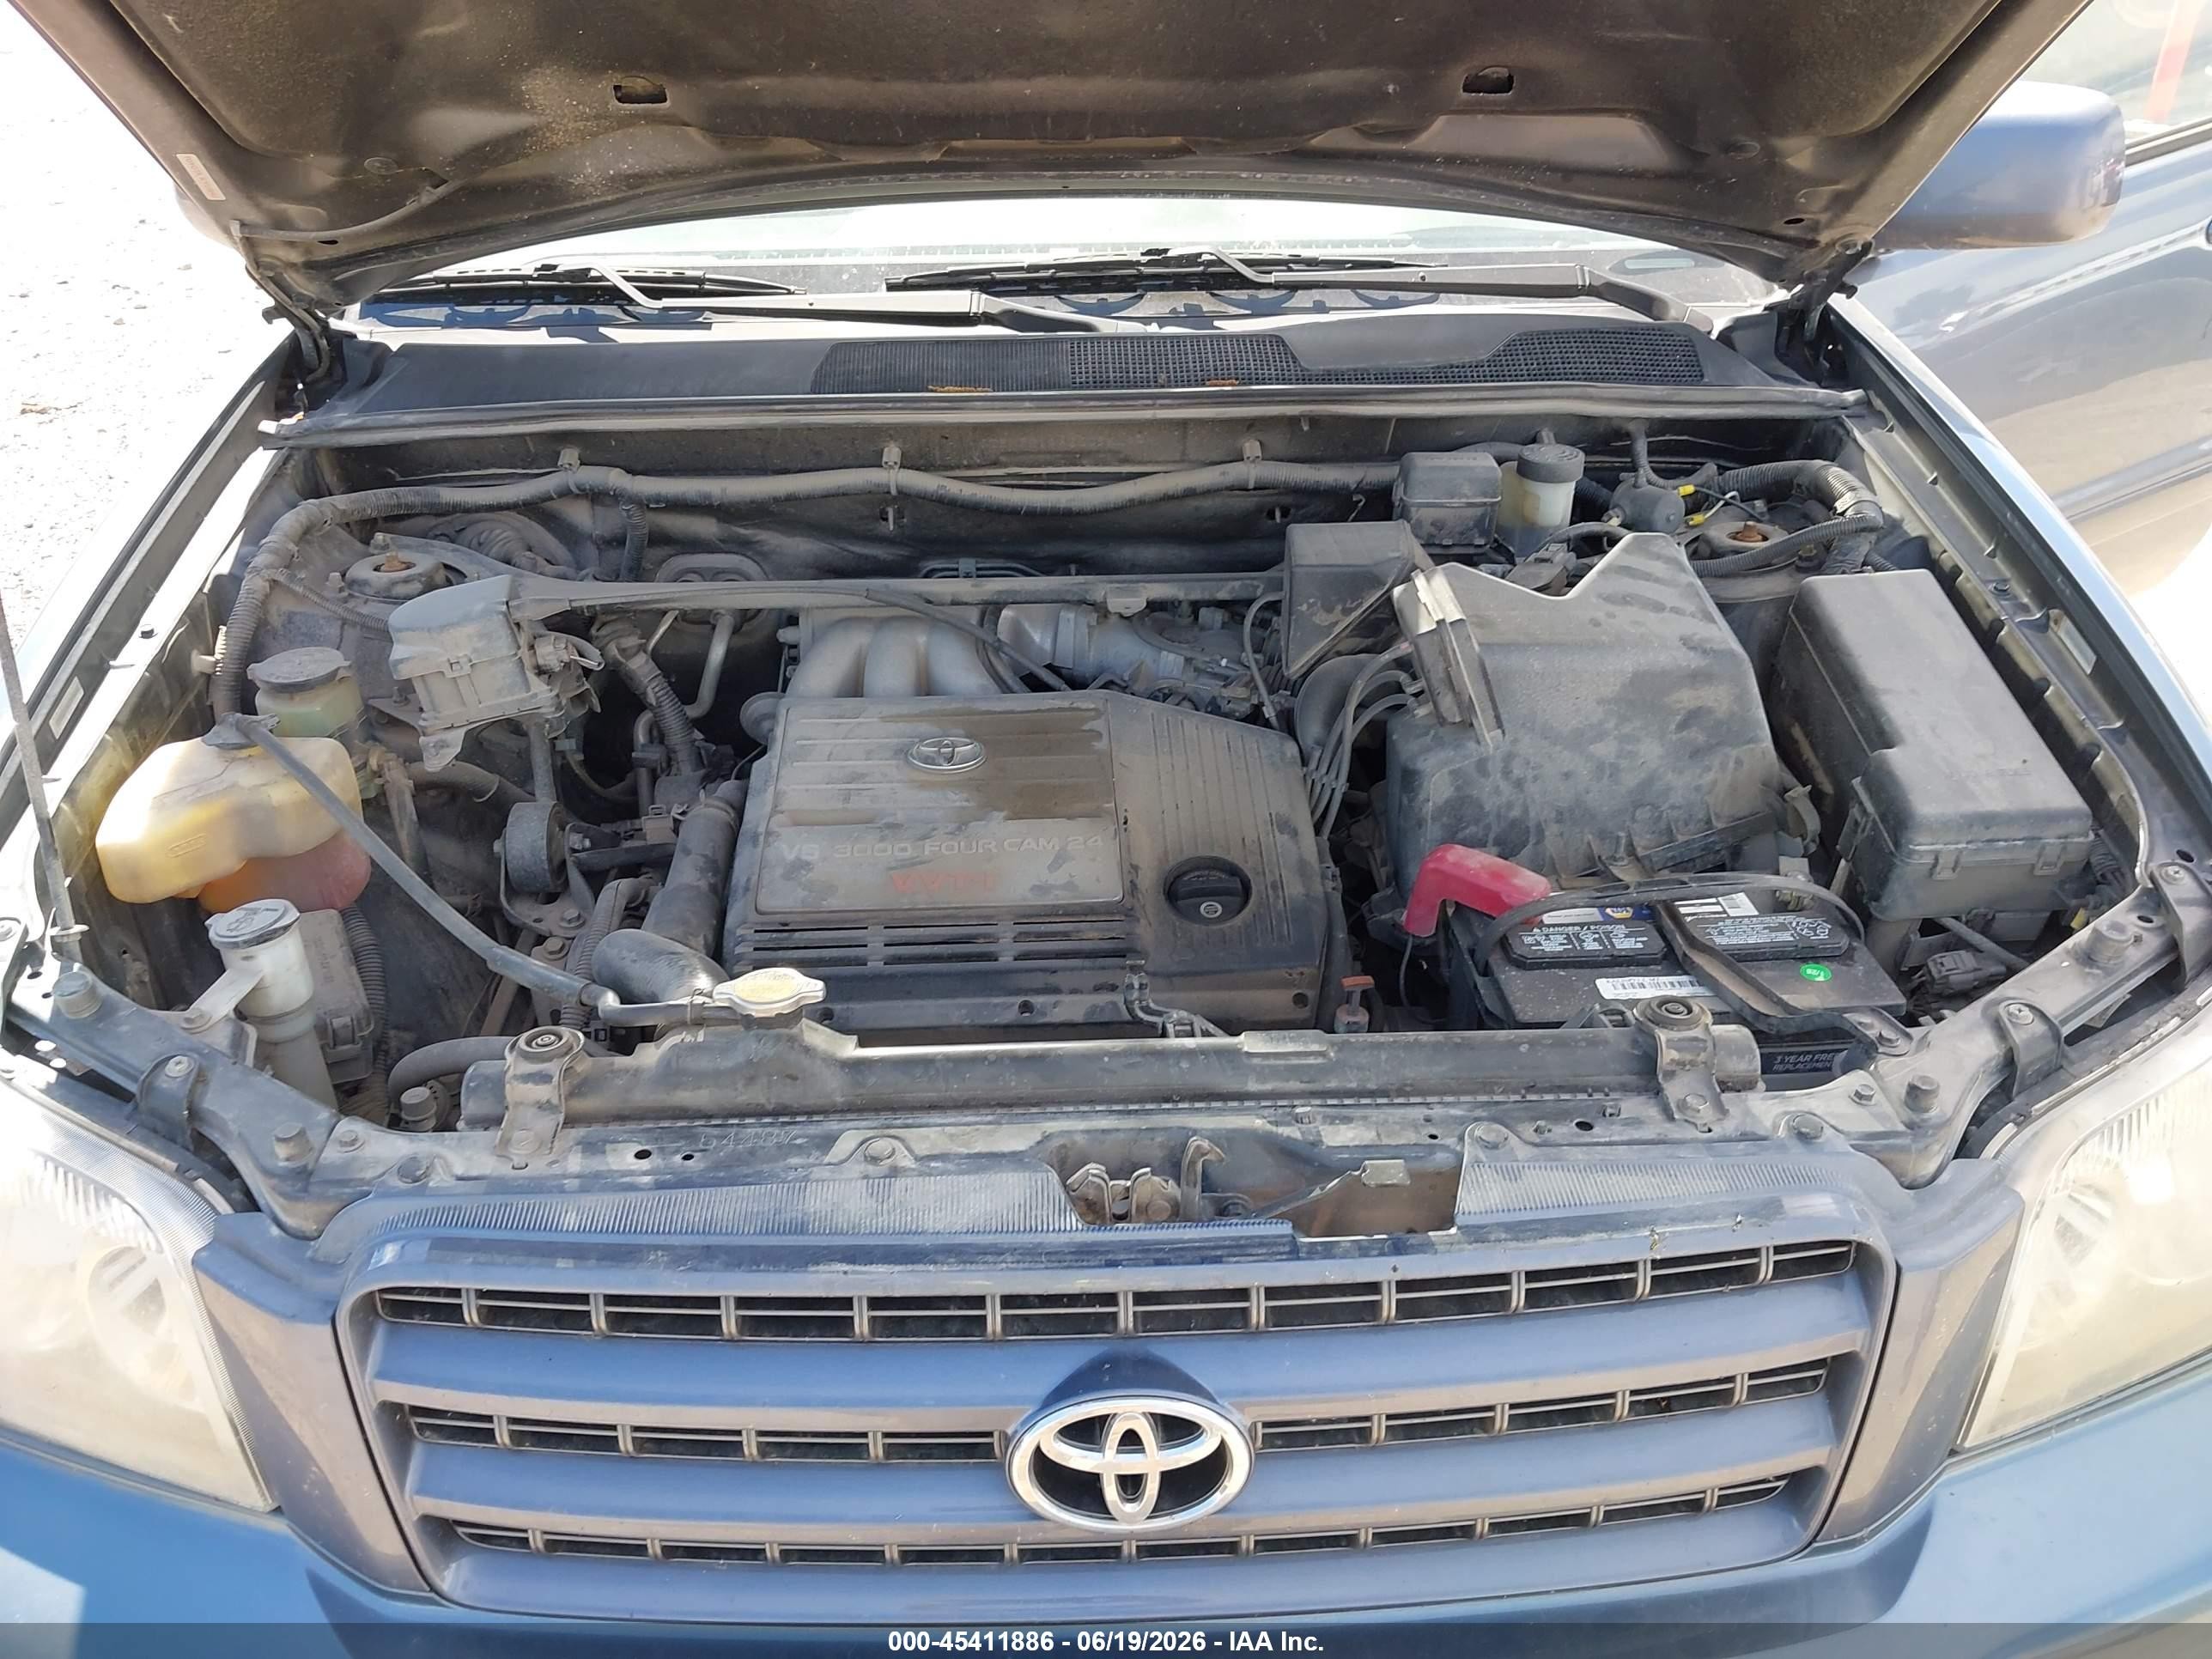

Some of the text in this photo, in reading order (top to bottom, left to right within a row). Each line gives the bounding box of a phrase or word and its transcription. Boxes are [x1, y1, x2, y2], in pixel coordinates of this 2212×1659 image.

[782, 836, 1103, 860] V6 3000 FOUR CAM 24
[1785, 1054, 1813, 1063] YEAR
[1814, 1052, 1835, 1061] FRE
